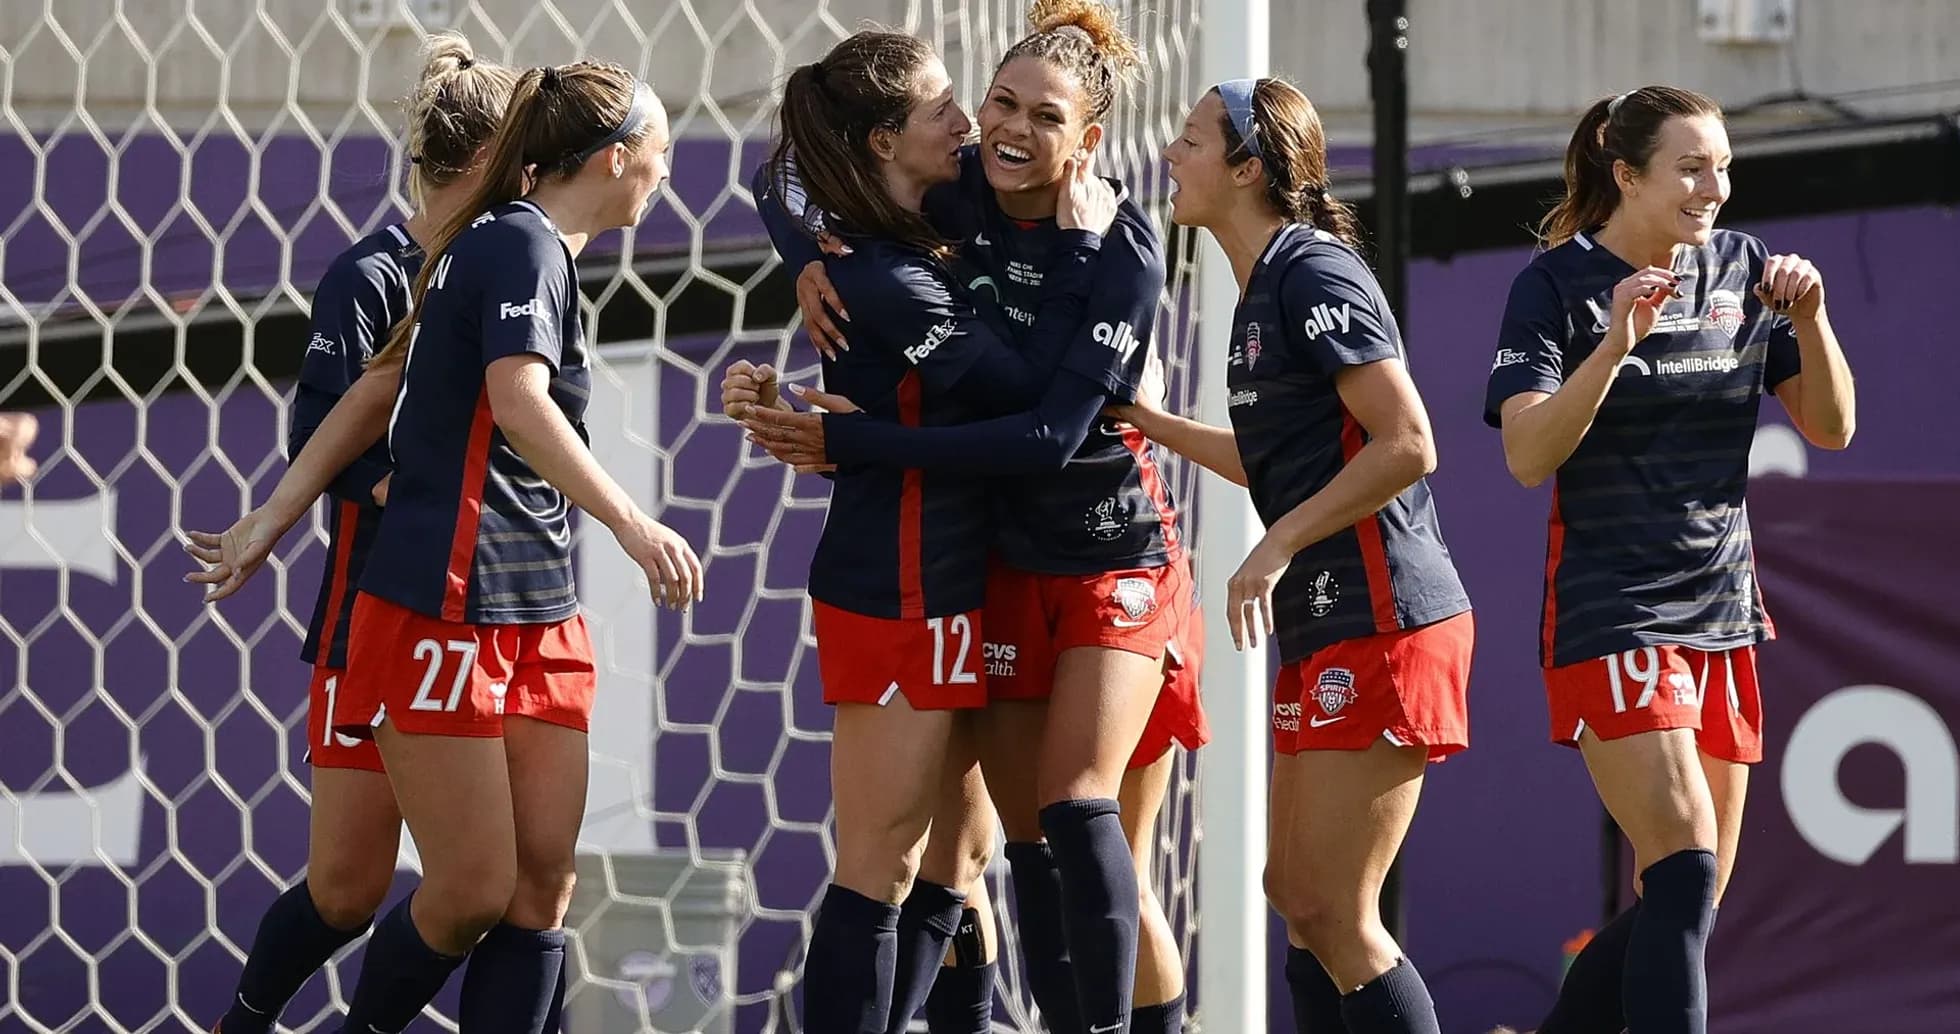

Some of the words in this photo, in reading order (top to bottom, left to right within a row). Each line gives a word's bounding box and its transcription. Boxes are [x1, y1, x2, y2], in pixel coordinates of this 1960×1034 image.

[1304, 302, 1350, 340] ally
[1092, 320, 1140, 364] ally
[1656, 356, 1738, 375] IntelliBridge
[927, 614, 977, 684] 12
[982, 642, 1016, 661] CVS
[409, 638, 477, 712] 27
[1320, 683, 1347, 695] SPIRIT
[1600, 646, 1660, 714] 19
[323, 675, 362, 747] 1
[960, 923, 974, 935] KT
